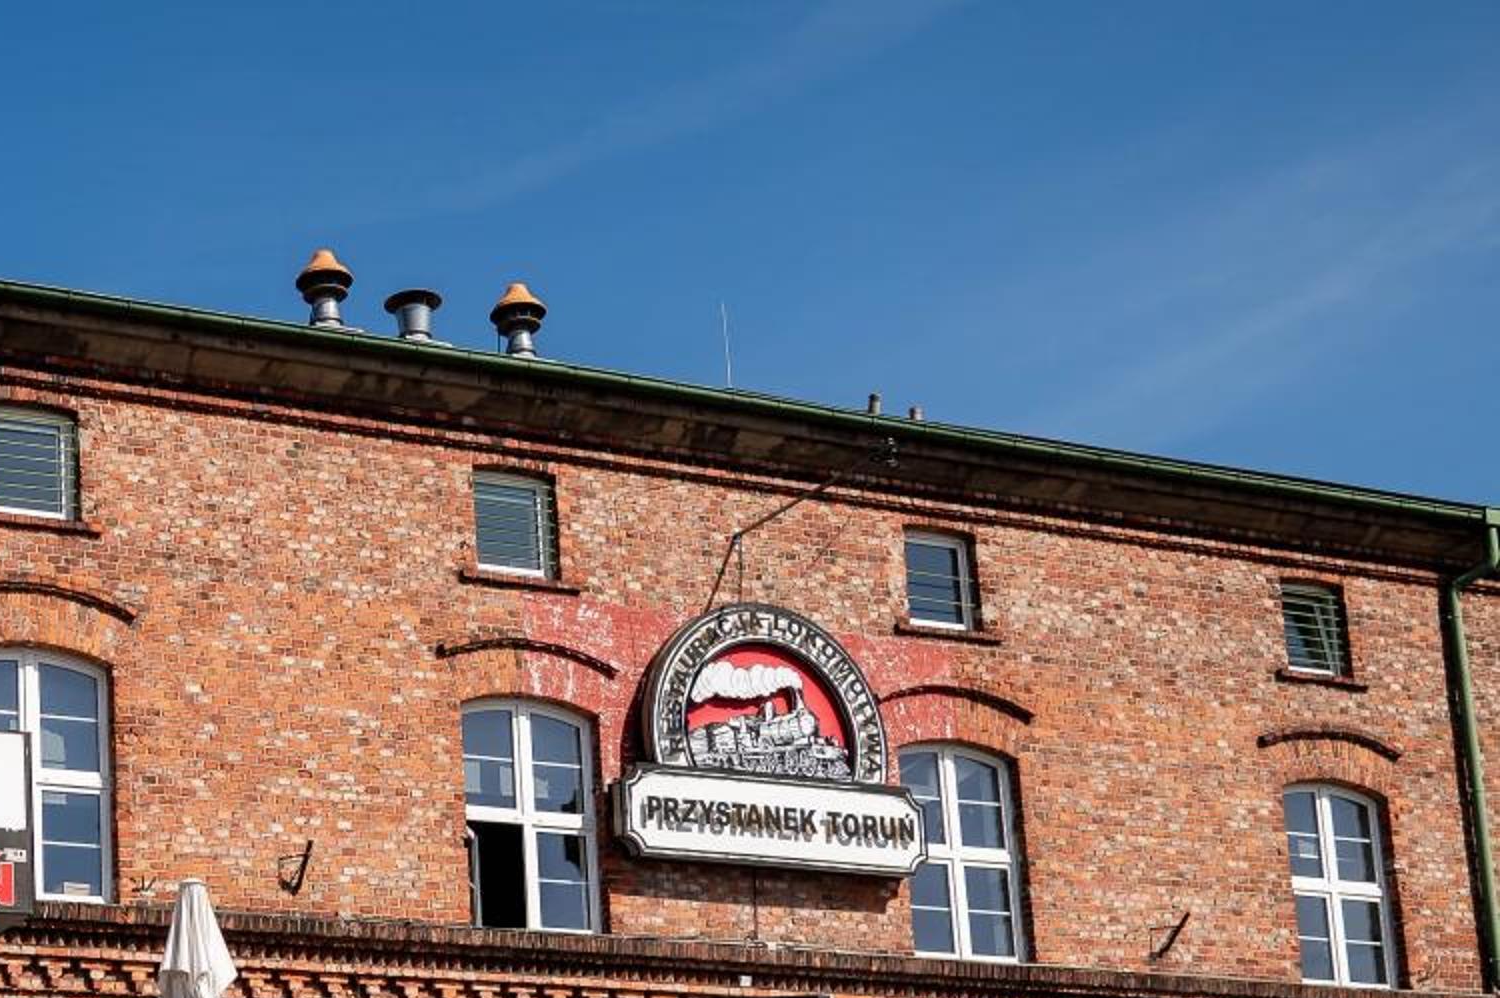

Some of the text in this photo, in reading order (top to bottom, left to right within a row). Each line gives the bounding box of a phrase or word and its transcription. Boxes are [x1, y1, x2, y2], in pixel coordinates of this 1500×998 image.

[662, 611, 882, 775] RESTAURACJA LOKOMOTYWA
[645, 794, 915, 843] PRZYSTANEK TORUŃ
